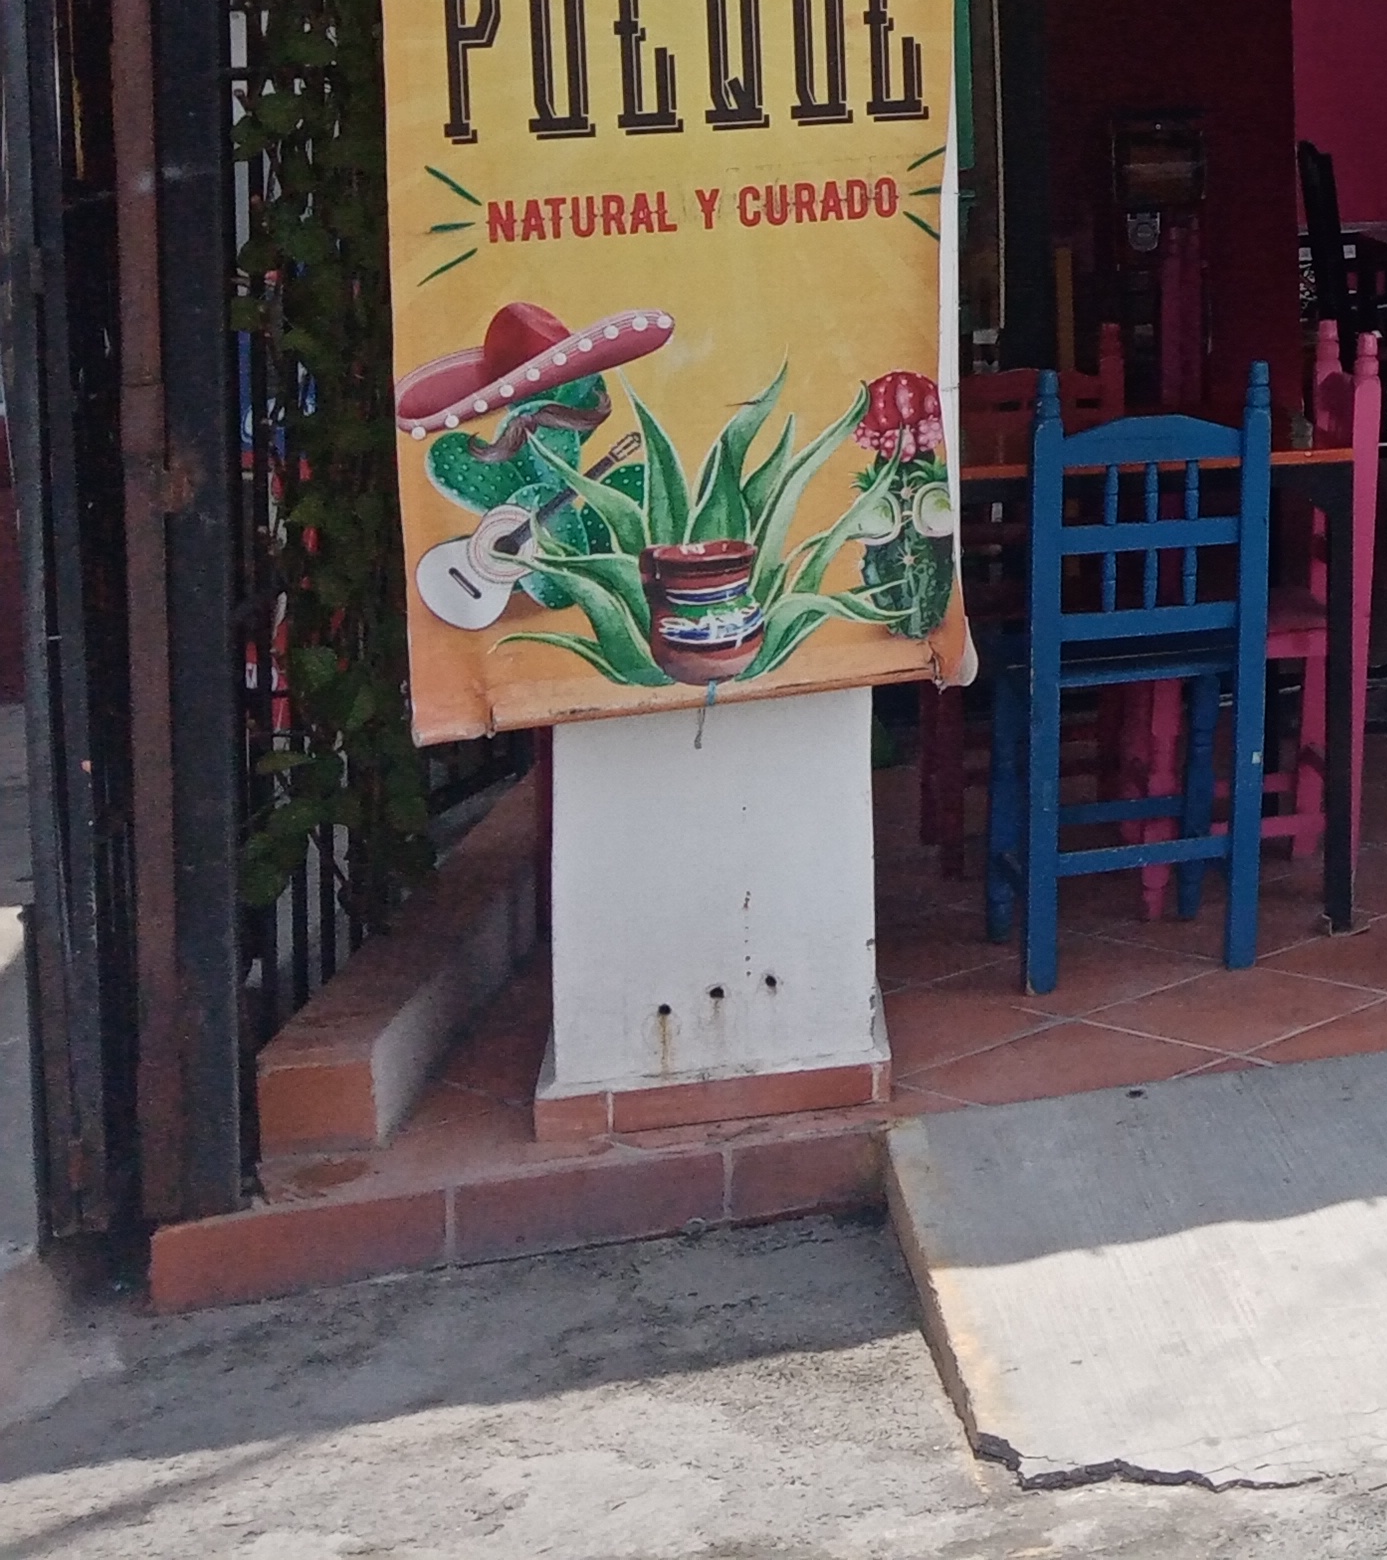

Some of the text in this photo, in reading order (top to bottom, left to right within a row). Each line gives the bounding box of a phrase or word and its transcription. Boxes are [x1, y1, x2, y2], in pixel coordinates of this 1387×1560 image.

[487, 177, 900, 243] NATURAL Y CURADO
